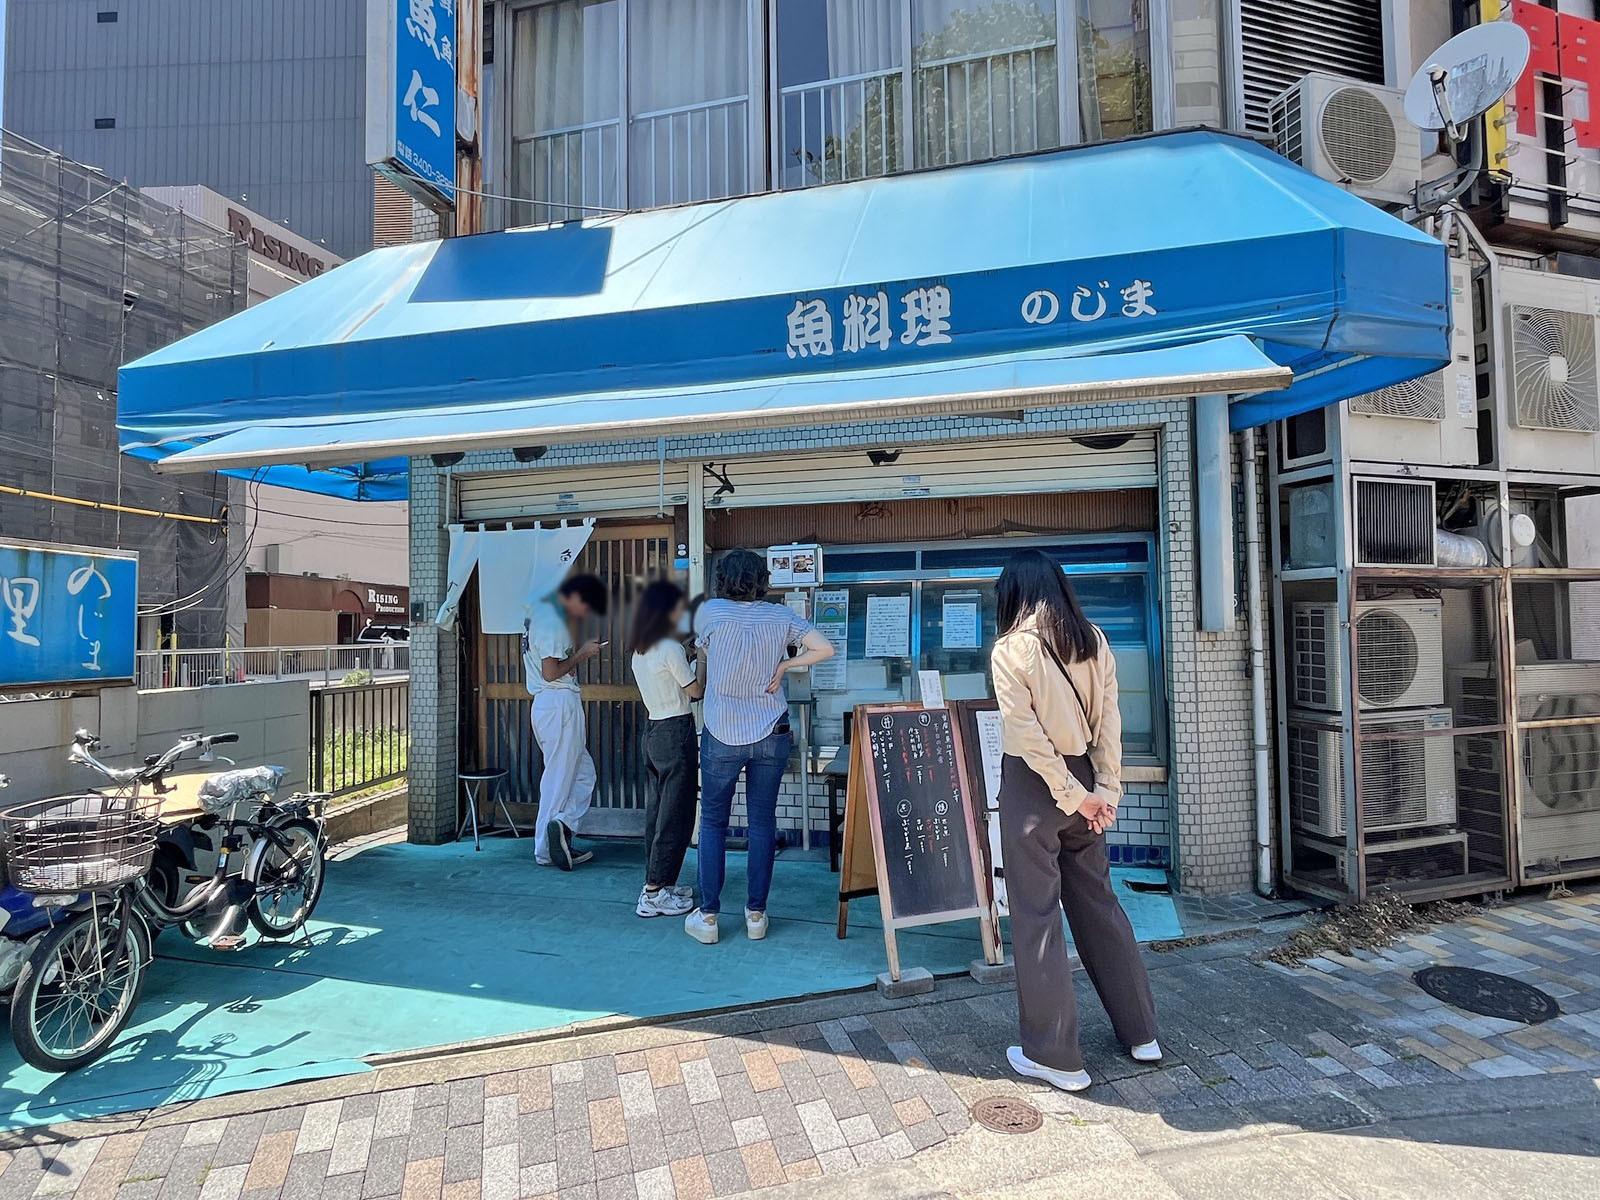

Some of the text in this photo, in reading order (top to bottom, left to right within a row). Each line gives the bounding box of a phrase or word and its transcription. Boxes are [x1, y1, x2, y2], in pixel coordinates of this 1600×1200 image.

[228, 208, 324, 278] RISING
[786, 285, 953, 358] 魚料理
[1020, 278, 1159, 326] のじま
[67, 560, 112, 671] のじま
[368, 589, 399, 604] RISING
